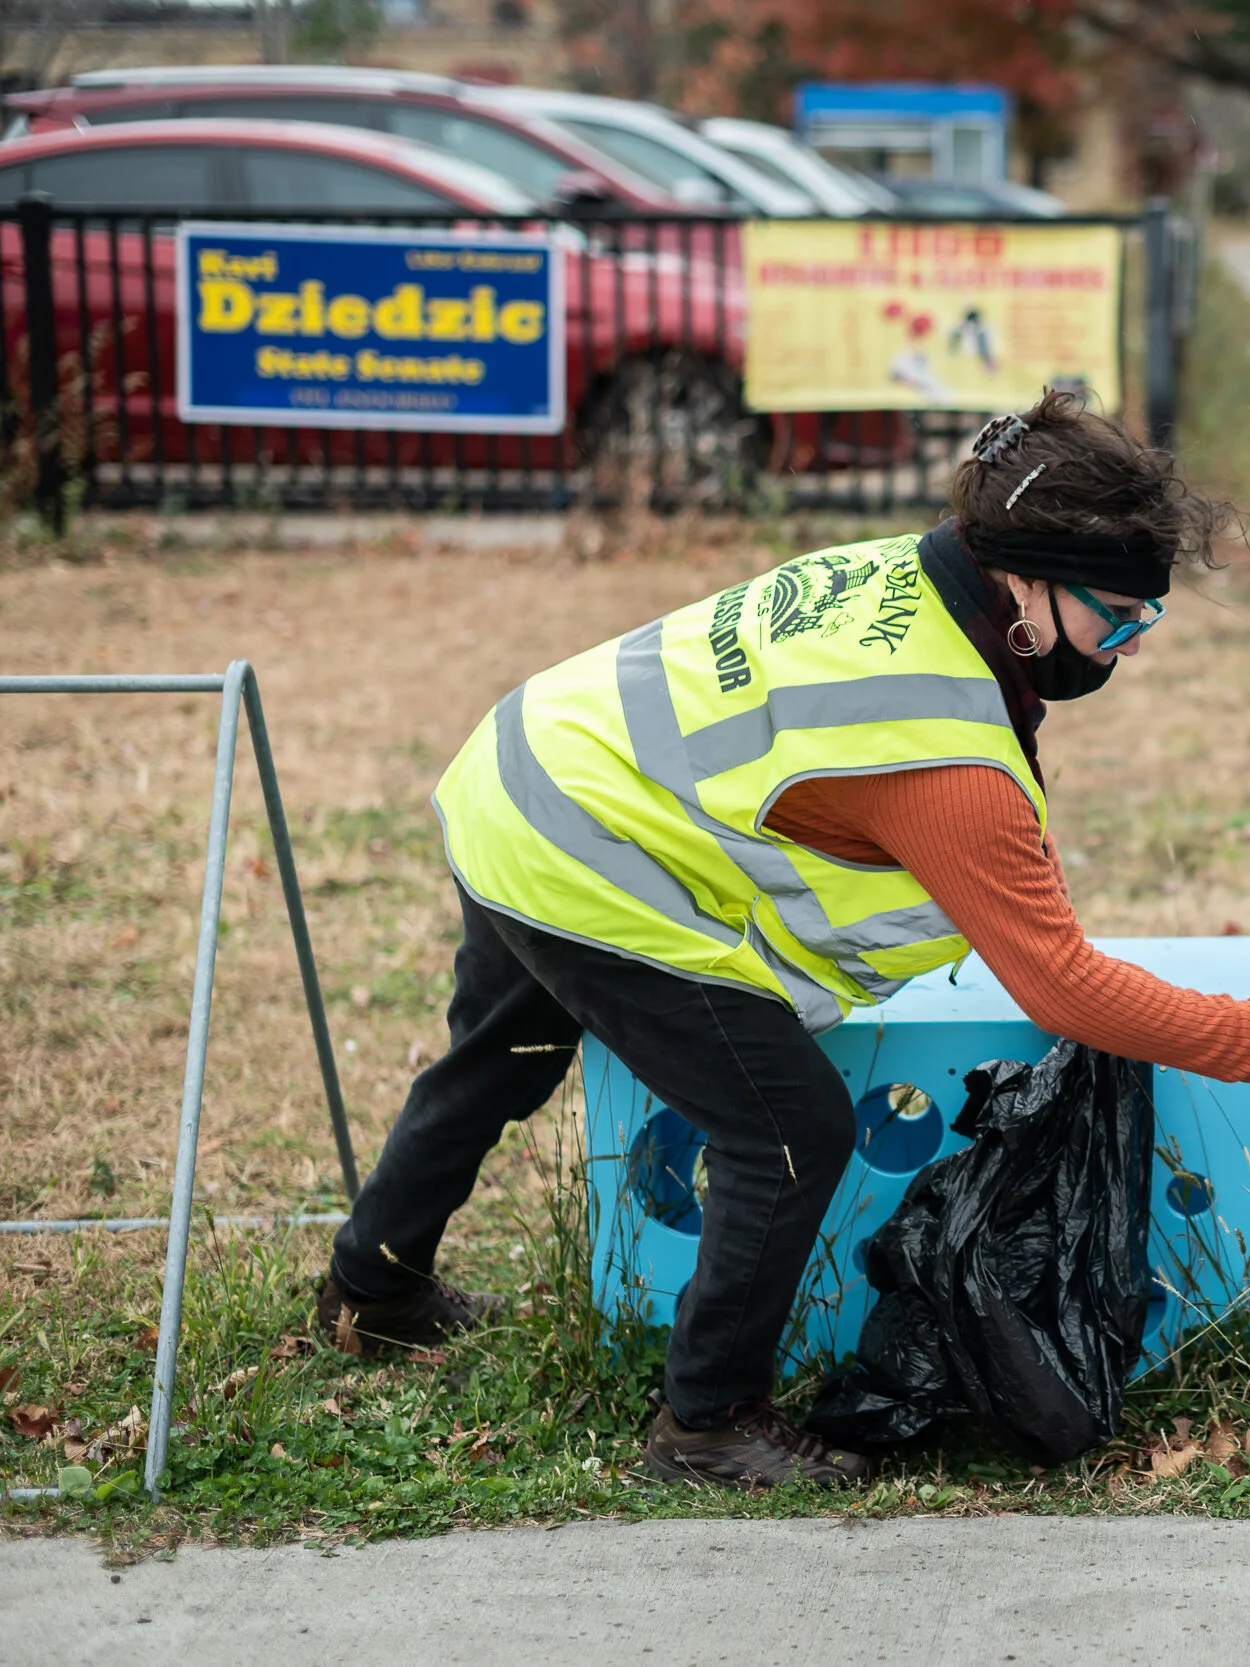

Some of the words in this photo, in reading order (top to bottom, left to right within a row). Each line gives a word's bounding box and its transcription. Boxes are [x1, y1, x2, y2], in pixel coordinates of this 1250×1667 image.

[199, 280, 543, 342] Dziedzic
[258, 348, 350, 378] State
[356, 351, 482, 383] Senate
[859, 568, 922, 656] BANK
